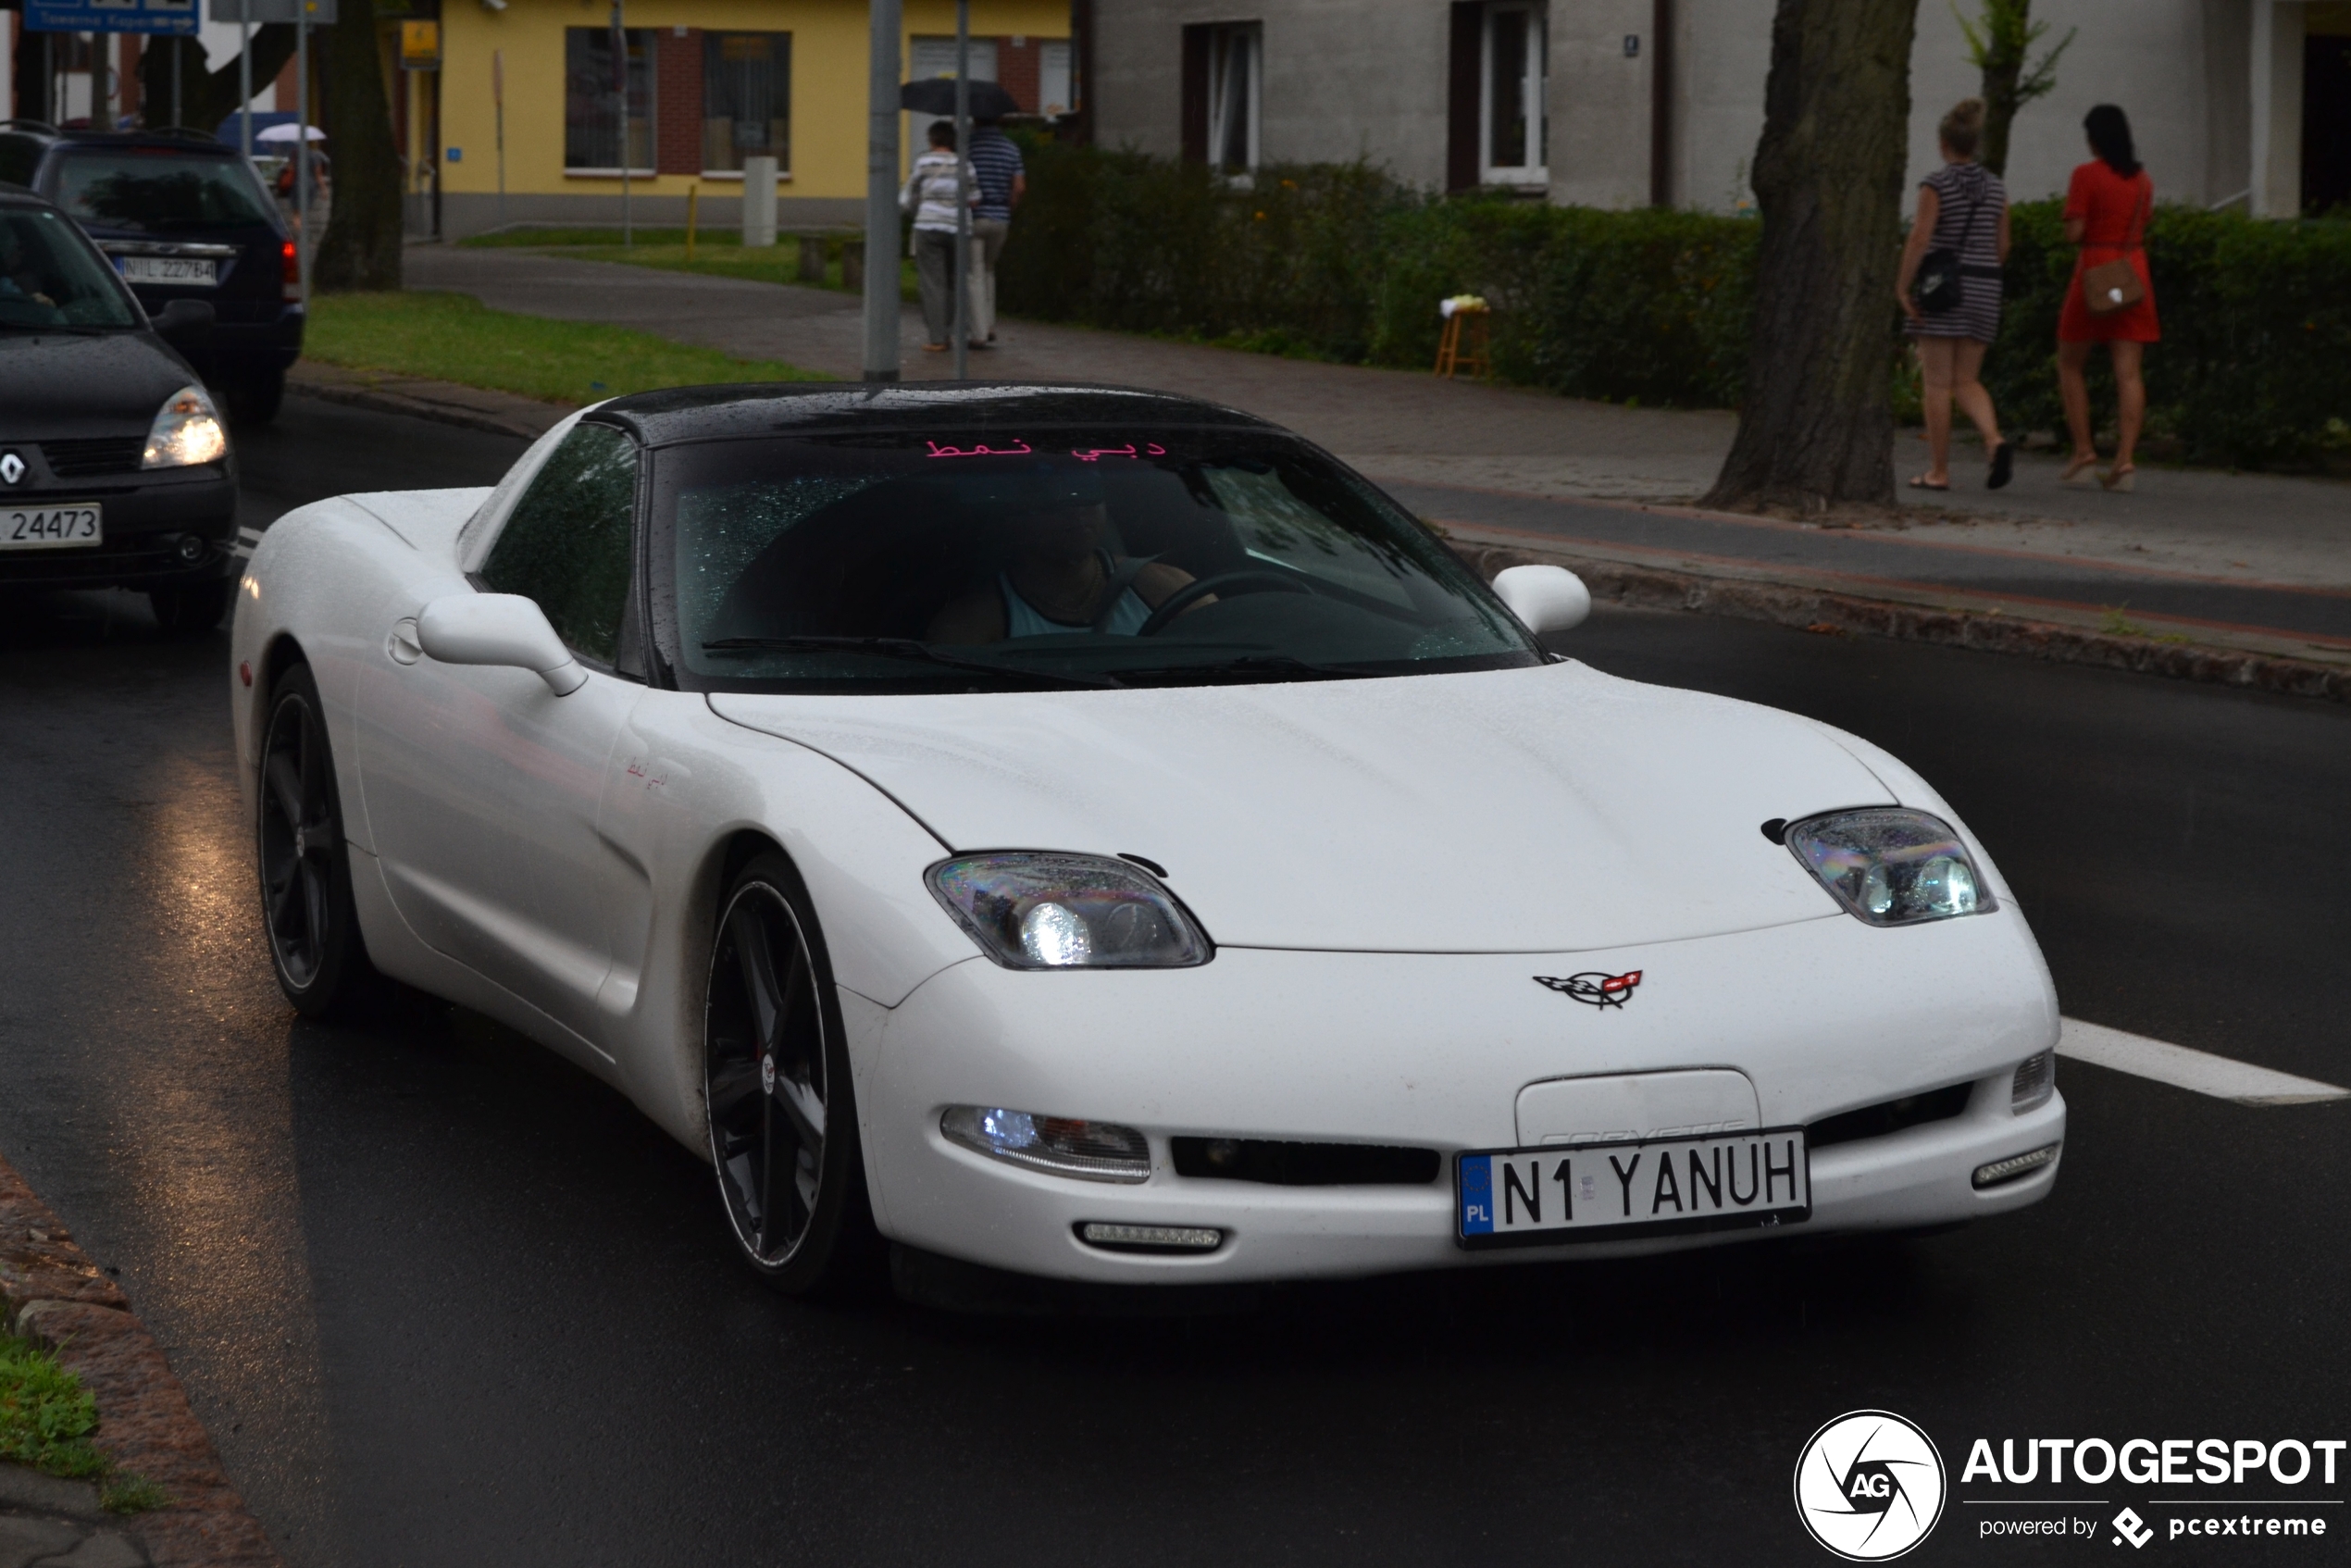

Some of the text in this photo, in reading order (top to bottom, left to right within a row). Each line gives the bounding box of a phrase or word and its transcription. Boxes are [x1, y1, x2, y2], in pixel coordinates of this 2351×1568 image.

[125, 259, 156, 277] NIL
[11, 510, 96, 540] 24473
[1503, 1139, 1797, 1225] N1 YANUH
[1467, 1205, 1489, 1223] PL
